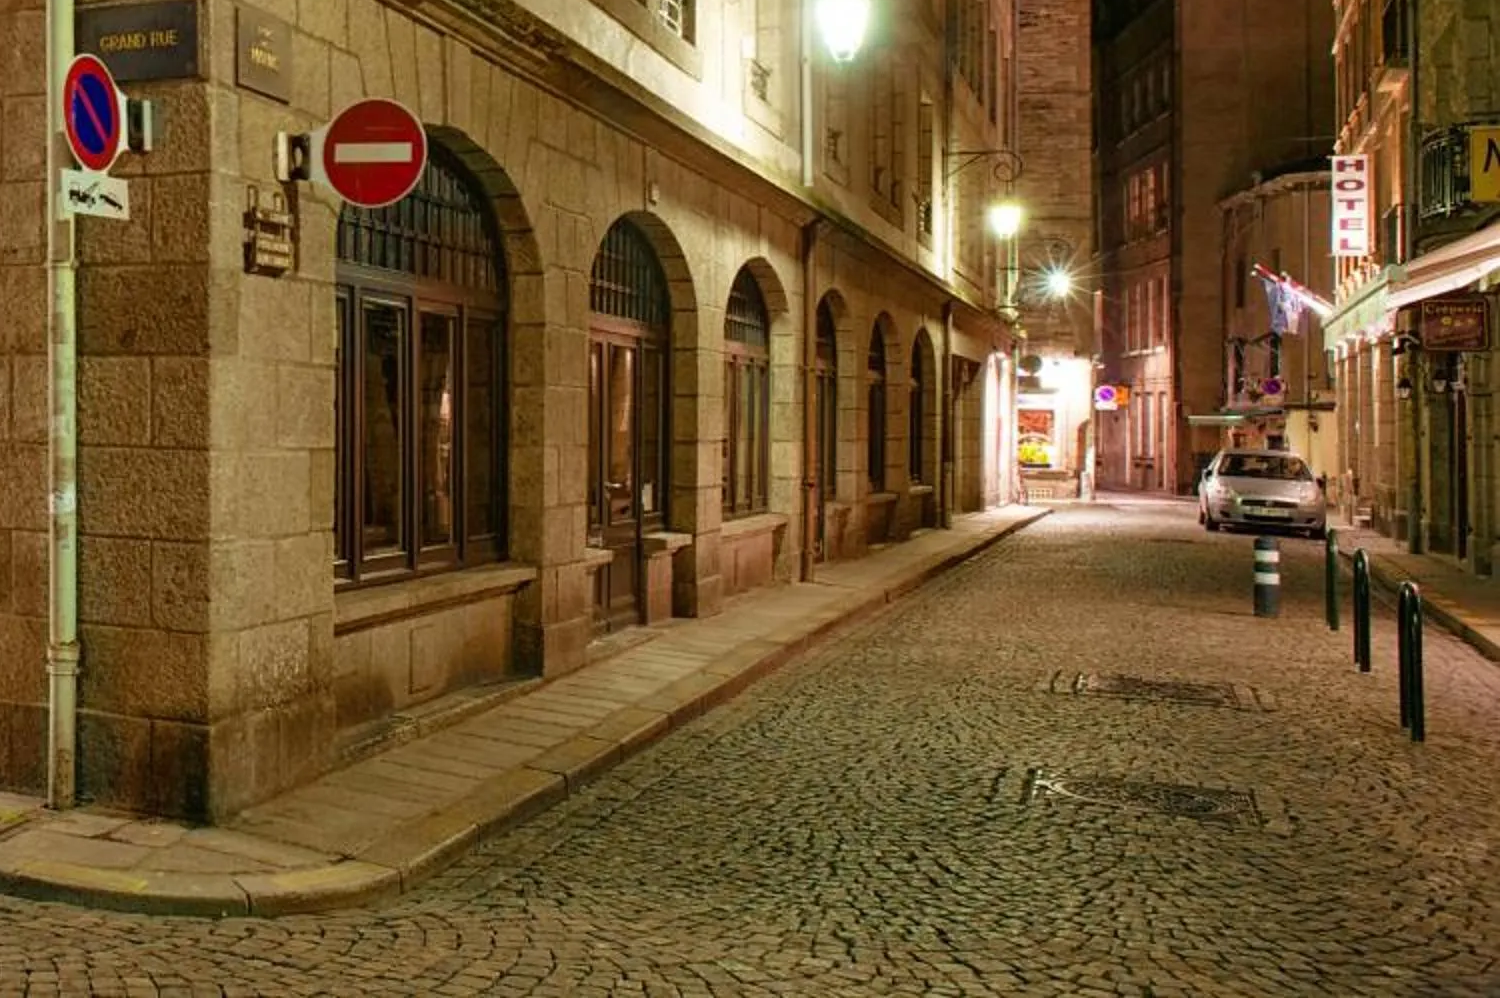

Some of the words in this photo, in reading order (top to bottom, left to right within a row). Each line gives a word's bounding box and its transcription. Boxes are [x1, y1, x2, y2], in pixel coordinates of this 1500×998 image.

[100, 33, 147, 53] GRAND
[150, 29, 179, 48] RUE
[1336, 159, 1364, 250] HOTEL
